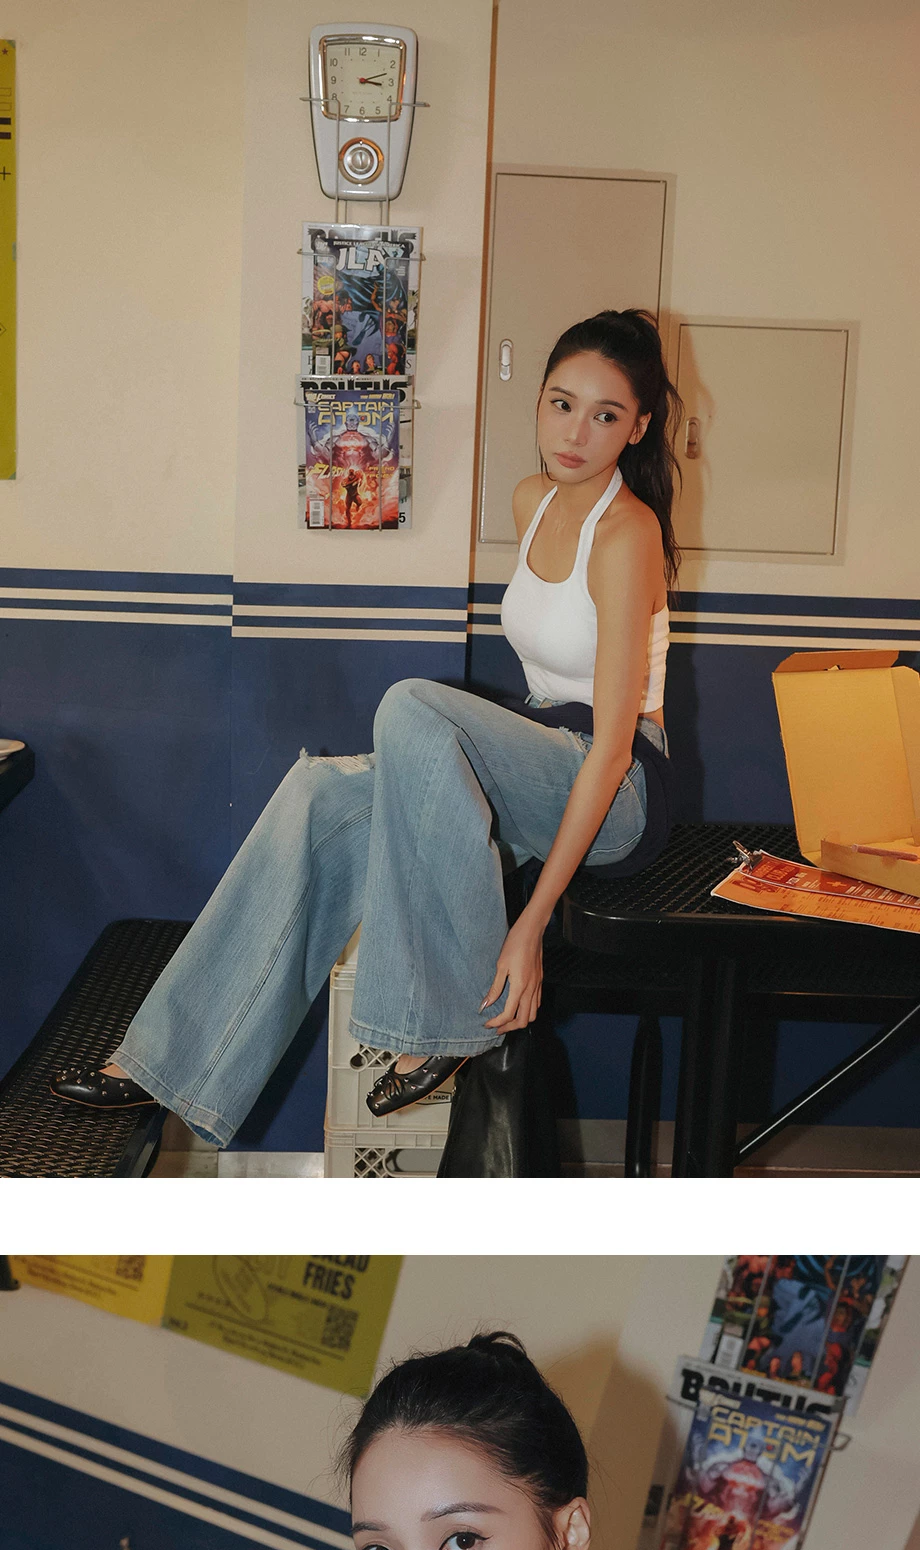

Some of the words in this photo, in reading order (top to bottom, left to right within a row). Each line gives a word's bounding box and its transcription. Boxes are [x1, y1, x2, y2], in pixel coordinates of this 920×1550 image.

[359, 47, 367, 56] 12
[329, 58, 338, 67] 10
[390, 60, 396, 69] 2
[331, 76, 337, 84] 9
[388, 78, 394, 87] 3
[344, 105, 350, 113] 7
[359, 106, 365, 115] 6
[375, 106, 381, 115] 5
[303, 1261, 356, 1300] FRIES
[711, 1406, 821, 1450] CAPTAIN
